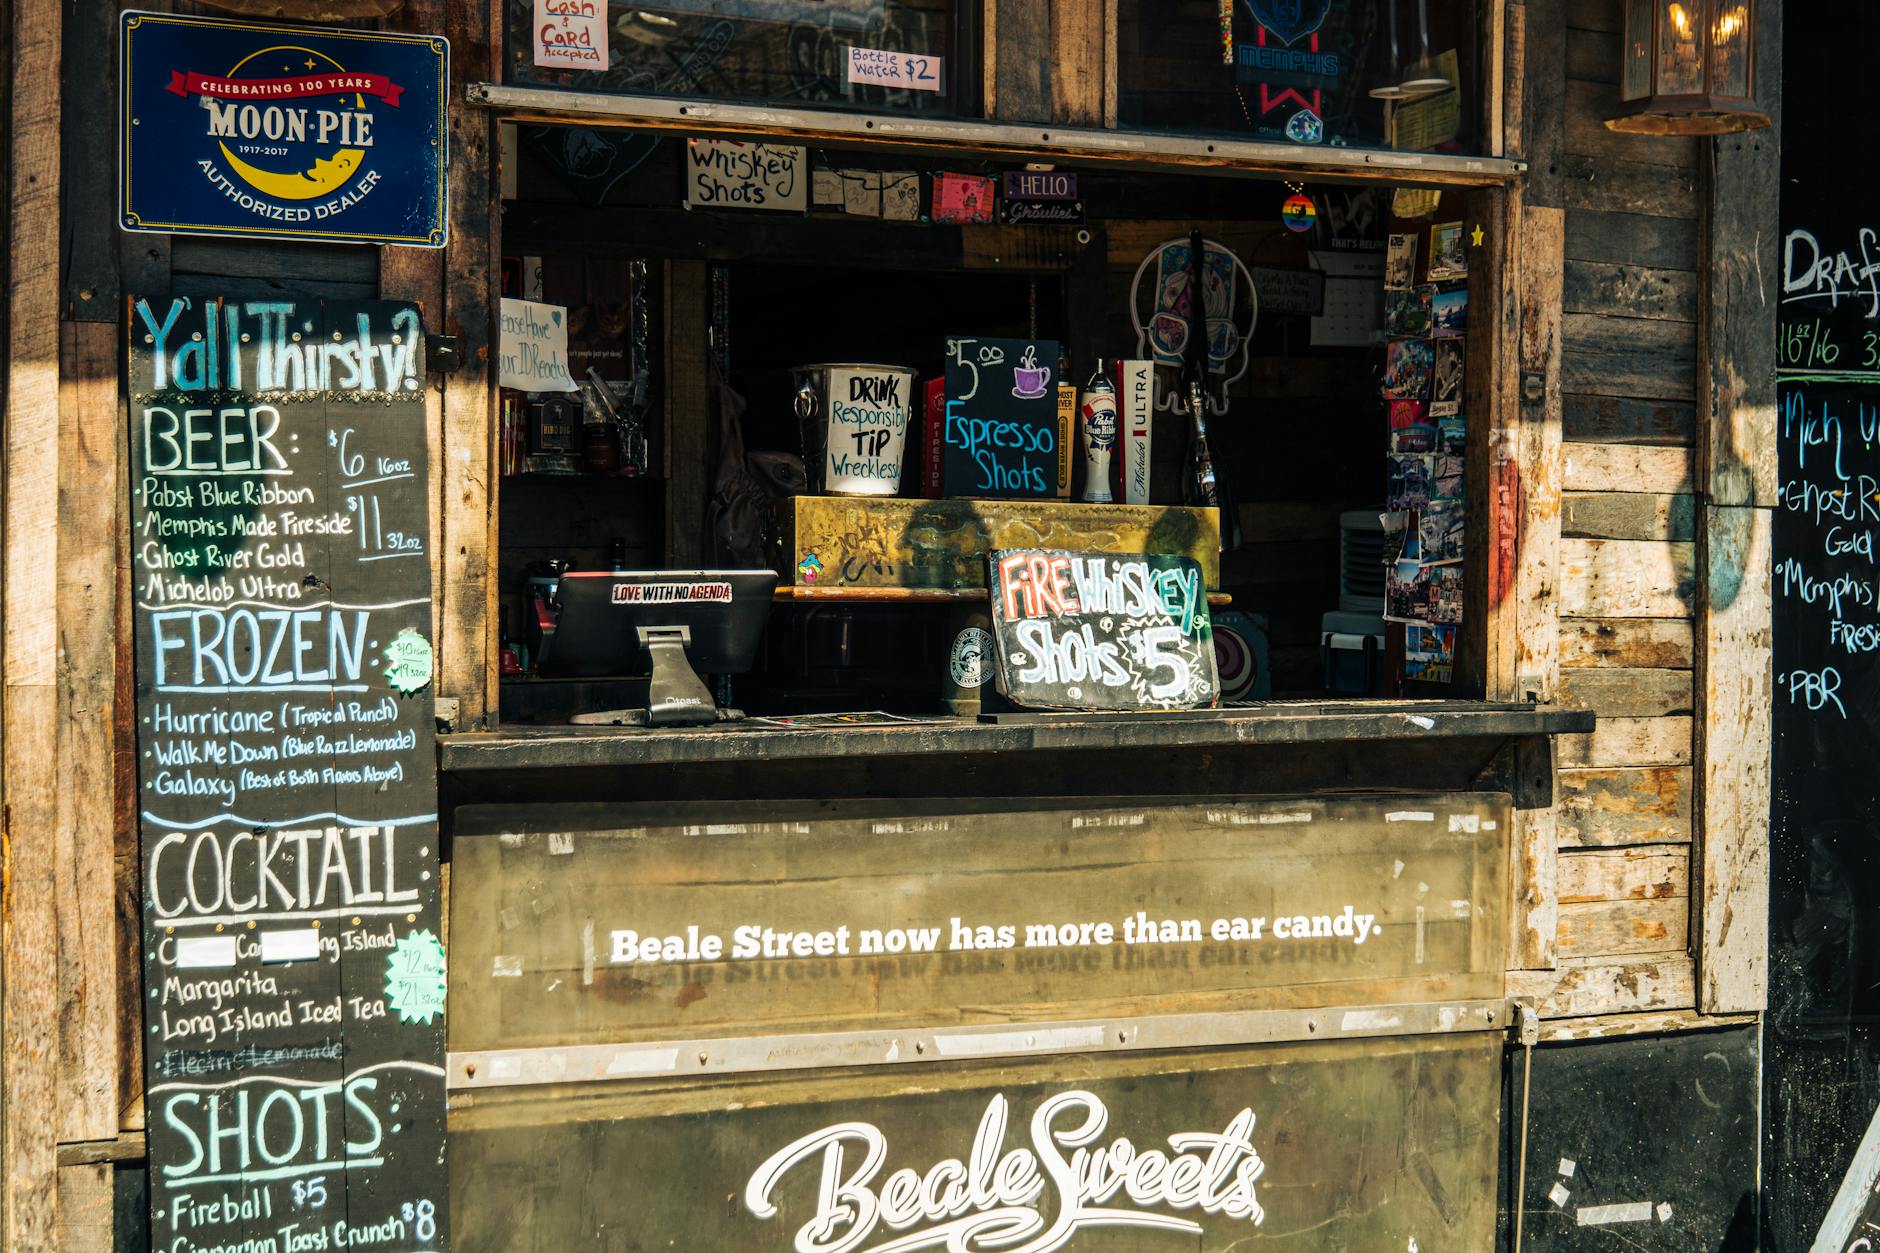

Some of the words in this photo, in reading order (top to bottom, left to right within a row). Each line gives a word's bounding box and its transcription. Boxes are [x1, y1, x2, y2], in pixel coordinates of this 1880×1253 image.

[852, 48, 897, 65] Bottle
[905, 59, 936, 82] $2
[1238, 44, 1339, 76] MEMPHIS
[200, 80, 293, 95] CELEBRATING
[299, 80, 323, 92] 100
[328, 77, 372, 89] YEARS
[239, 145, 289, 157] 1917-2017
[691, 146, 794, 198] Whiskey
[198, 157, 311, 222] AUTHORIZED
[316, 169, 382, 219] DEALER
[698, 173, 765, 204] Shots
[1020, 175, 1068, 196] HELLO
[135, 296, 242, 392] Y'all
[245, 301, 420, 392] Thirsty?
[1136, 369, 1147, 425] ULTRA
[144, 405, 300, 472] BEER:
[328, 428, 365, 477] $6
[945, 400, 1054, 459] Espresso
[1784, 391, 1850, 479] Mich
[378, 456, 411, 475] 16oz
[932, 421, 941, 488] FIRESIDE
[975, 449, 1047, 492] Shots
[1135, 440, 1146, 497] Michelob
[142, 477, 193, 508] Pabst
[199, 481, 239, 506] Blue
[243, 480, 315, 506] Ribbon
[1785, 480, 1855, 526] Ghost
[143, 511, 228, 541] Memphis
[231, 516, 277, 538] Made
[281, 511, 354, 536] Fireside
[386, 532, 422, 550] 32oz
[1825, 526, 1873, 564] Gold
[142, 540, 200, 570] Ghost
[207, 544, 253, 568] River
[257, 540, 305, 569] Gold
[147, 574, 234, 603] Michelob
[241, 574, 301, 600] Ultra
[614, 586, 641, 601] LOVE
[643, 586, 672, 601] WITH
[675, 586, 689, 600] NO
[689, 585, 730, 600] AGENDA
[1783, 557, 1873, 619] Memphis
[152, 608, 380, 686] FROZEN:
[1128, 625, 1190, 699] $5
[675, 696, 702, 705] toast
[1790, 666, 1847, 720] PBR
[154, 703, 274, 734] Hurricane
[349, 697, 399, 723] Punch)
[154, 740, 202, 768] Walk
[205, 741, 227, 766] Me
[230, 741, 278, 765] Down
[282, 735, 315, 758] (Blue
[316, 734, 349, 756] Razz
[350, 728, 416, 754] Lemonade)
[156, 770, 236, 807] Galaxy
[241, 768, 272, 791] (Best
[273, 769, 286, 787] of
[287, 768, 319, 787] Both
[364, 761, 403, 784] Above)
[150, 825, 431, 919] COCKTAIL:
[341, 924, 396, 950] Island
[610, 926, 723, 963] Beale
[732, 925, 850, 959] Street
[859, 927, 941, 954] now
[949, 917, 1016, 948] has
[1025, 920, 1114, 948] more
[1122, 911, 1202, 944] than
[1211, 916, 1265, 941] ear
[1272, 905, 1382, 944] candy.
[161, 971, 278, 1009] Margarita
[162, 1009, 217, 1043] Long
[219, 1002, 293, 1031] Island
[299, 996, 342, 1023] Iced
[348, 997, 386, 1019] Tea
[248, 1037, 344, 1067] Lemonade
[163, 1077, 401, 1179] SHOTS:
[746, 1092, 1046, 1253] Beale
[1031, 1090, 1264, 1227] Sweets
[171, 1186, 271, 1231] Fireball
[290, 1176, 328, 1208] $5
[277, 1223, 329, 1253] Toast
[334, 1215, 405, 1249] Crunch
[401, 1199, 436, 1242] $8
